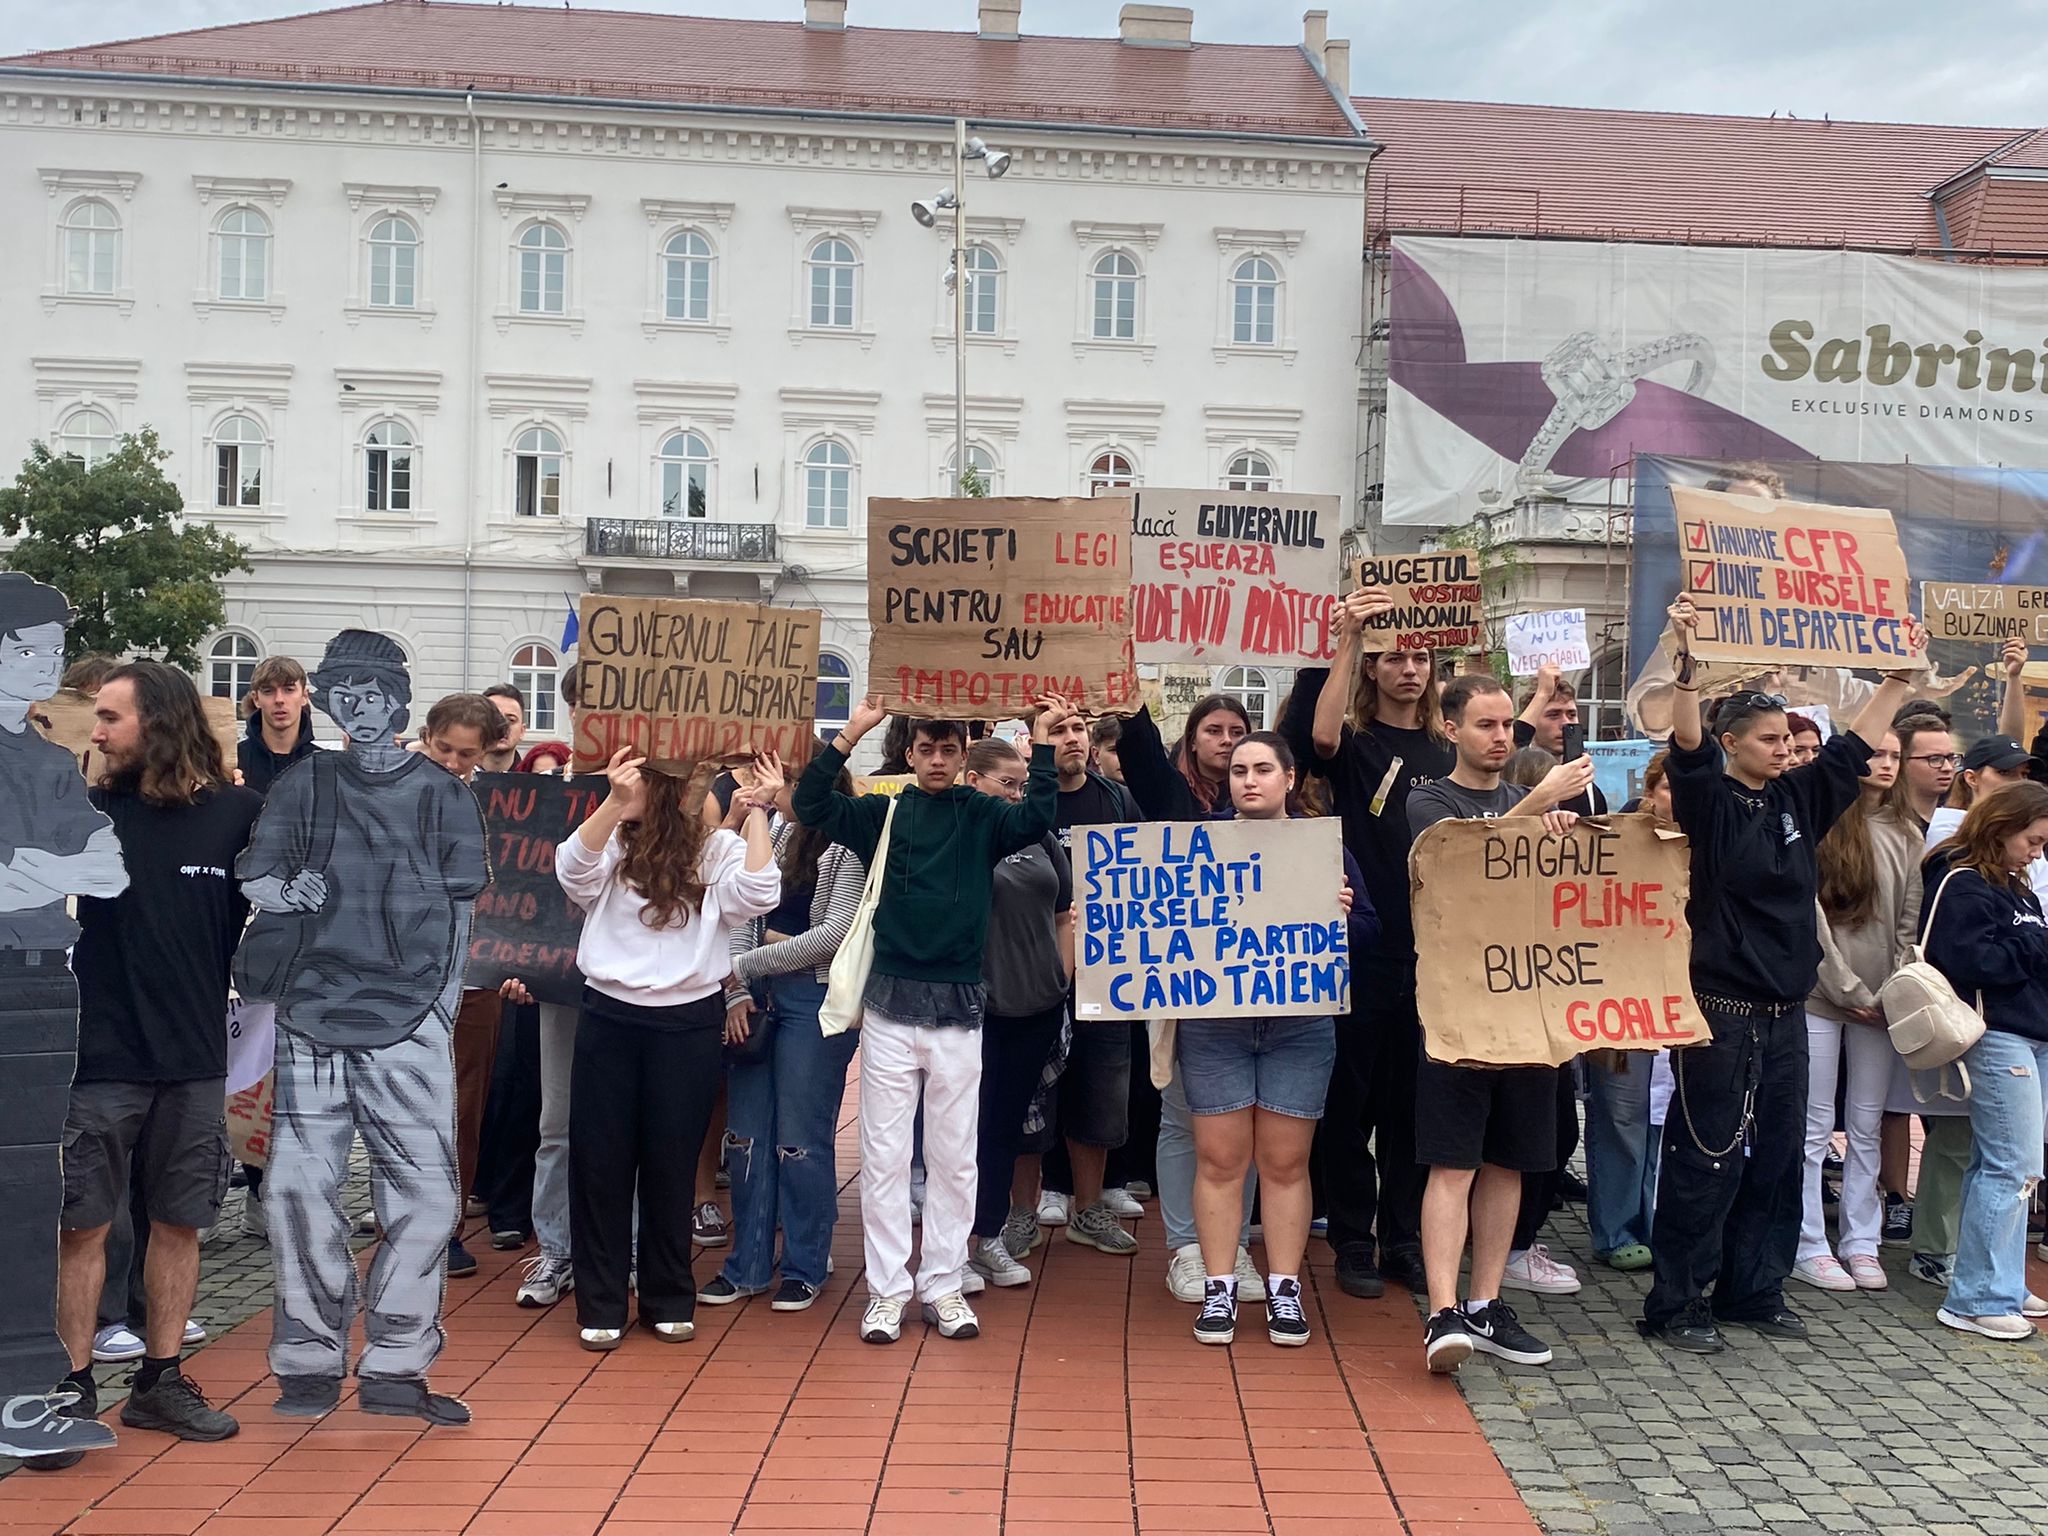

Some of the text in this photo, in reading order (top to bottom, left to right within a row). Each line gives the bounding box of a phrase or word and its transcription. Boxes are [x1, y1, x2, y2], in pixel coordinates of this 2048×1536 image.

[1791, 399, 2034, 423] EXCLUSIVE DIAMONDS
[888, 524, 1118, 570] SCRIEȚI LEGI
[1197, 504, 1325, 549] GUVERNUL
[1159, 541, 1276, 579] EȘUEAZĂ
[1361, 554, 1480, 587] BUGETUL
[1784, 527, 1865, 577] CFR
[885, 587, 1125, 630] PENTRU EDUCAȚIE
[1408, 583, 1482, 604] VOSTRU
[1716, 557, 1895, 618] IUNIE BURSELE
[588, 606, 733, 664] GUVERNUL
[1240, 578, 1338, 660] PLĂTESC
[1361, 605, 1479, 632] ABANDONUL
[1512, 611, 1586, 632] VIITORUL
[1531, 628, 1569, 645] NU E
[1719, 603, 1754, 646] MAI
[1760, 607, 1873, 655] DEPARTE
[1944, 612, 2028, 639] BUZUNAR
[981, 627, 1045, 661] SAU
[1511, 647, 1588, 673] NEGOCIABIL
[486, 787, 600, 826] NU TA
[499, 832, 556, 874] TUD
[1086, 826, 1141, 869] DE
[1162, 825, 1216, 864] LA
[1484, 834, 1621, 880] BAGAJE
[1552, 878, 1676, 939] PLINE,
[1085, 920, 1348, 966] DE LA PARTIDE
[1109, 965, 1217, 1012] CÂND
[1484, 942, 1603, 993] BURSE
[1565, 996, 1695, 1042] GOALE
